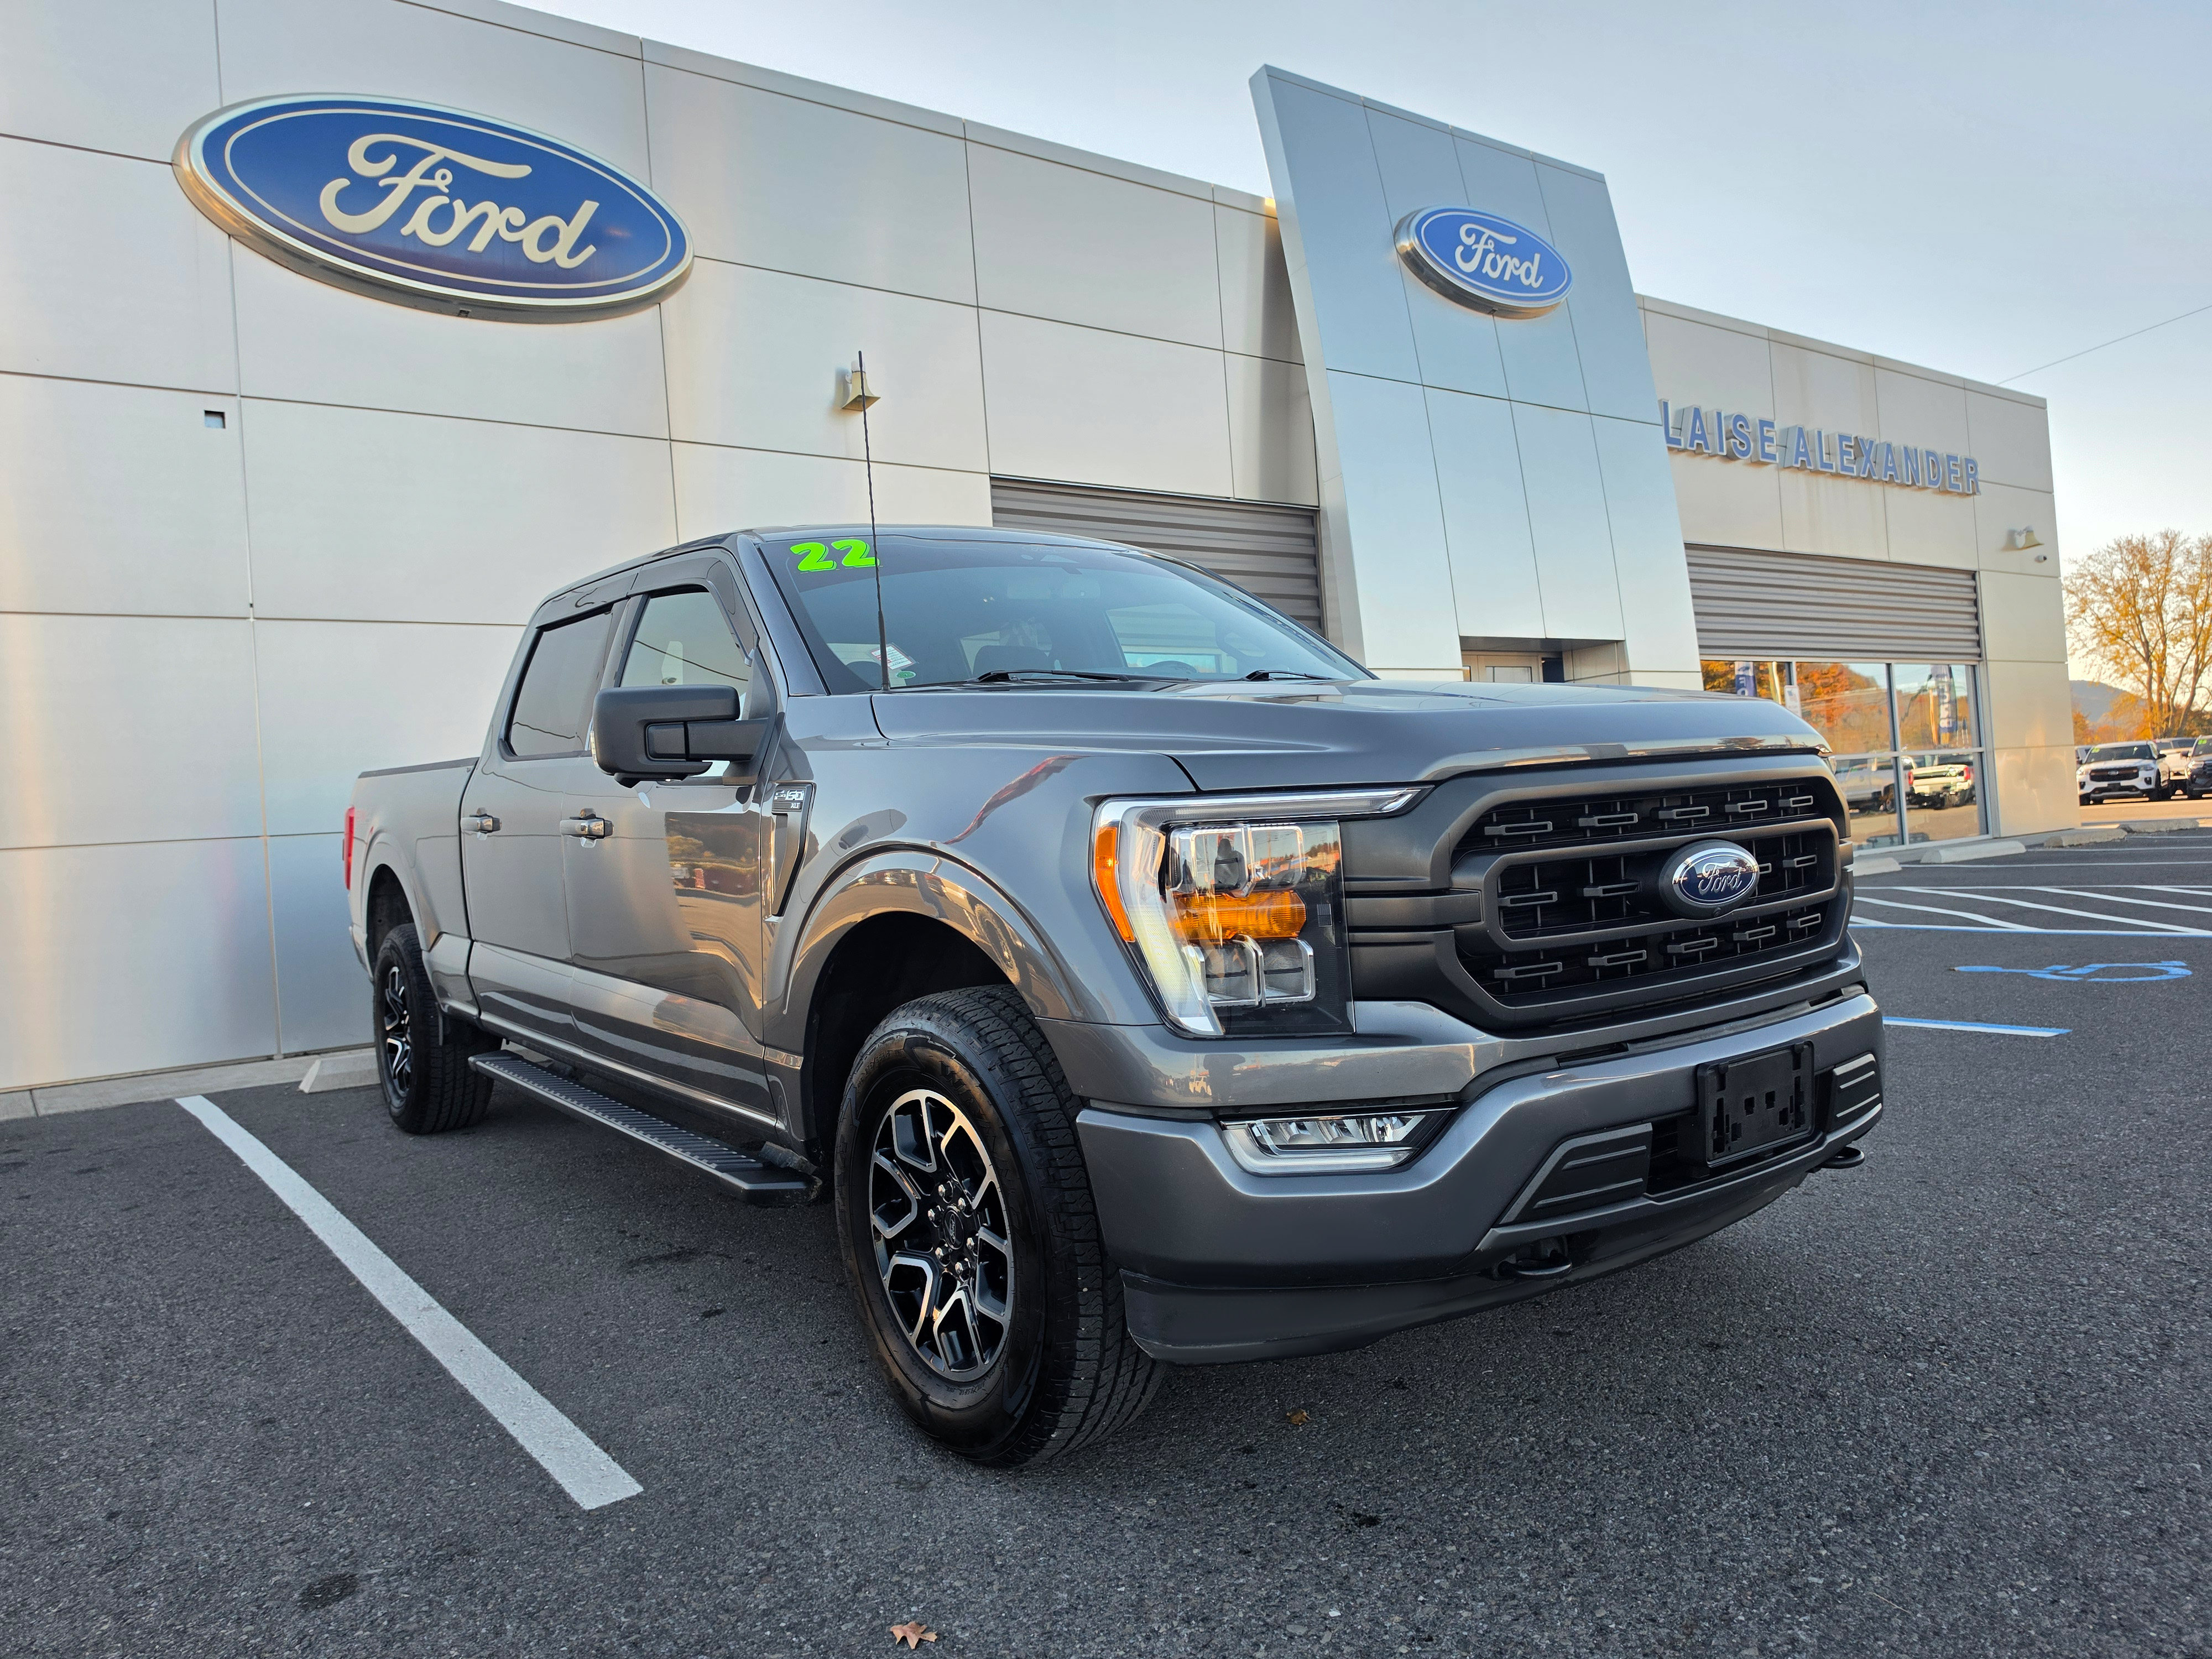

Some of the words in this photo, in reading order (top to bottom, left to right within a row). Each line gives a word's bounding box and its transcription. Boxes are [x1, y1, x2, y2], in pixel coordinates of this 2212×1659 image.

[320, 133, 599, 269] Ford
[1455, 223, 1543, 288] Ford
[1792, 425, 1980, 495] ALEXANDER
[790, 539, 880, 572] 22
[775, 790, 804, 800] F-150
[1698, 862, 1742, 895] Ford
